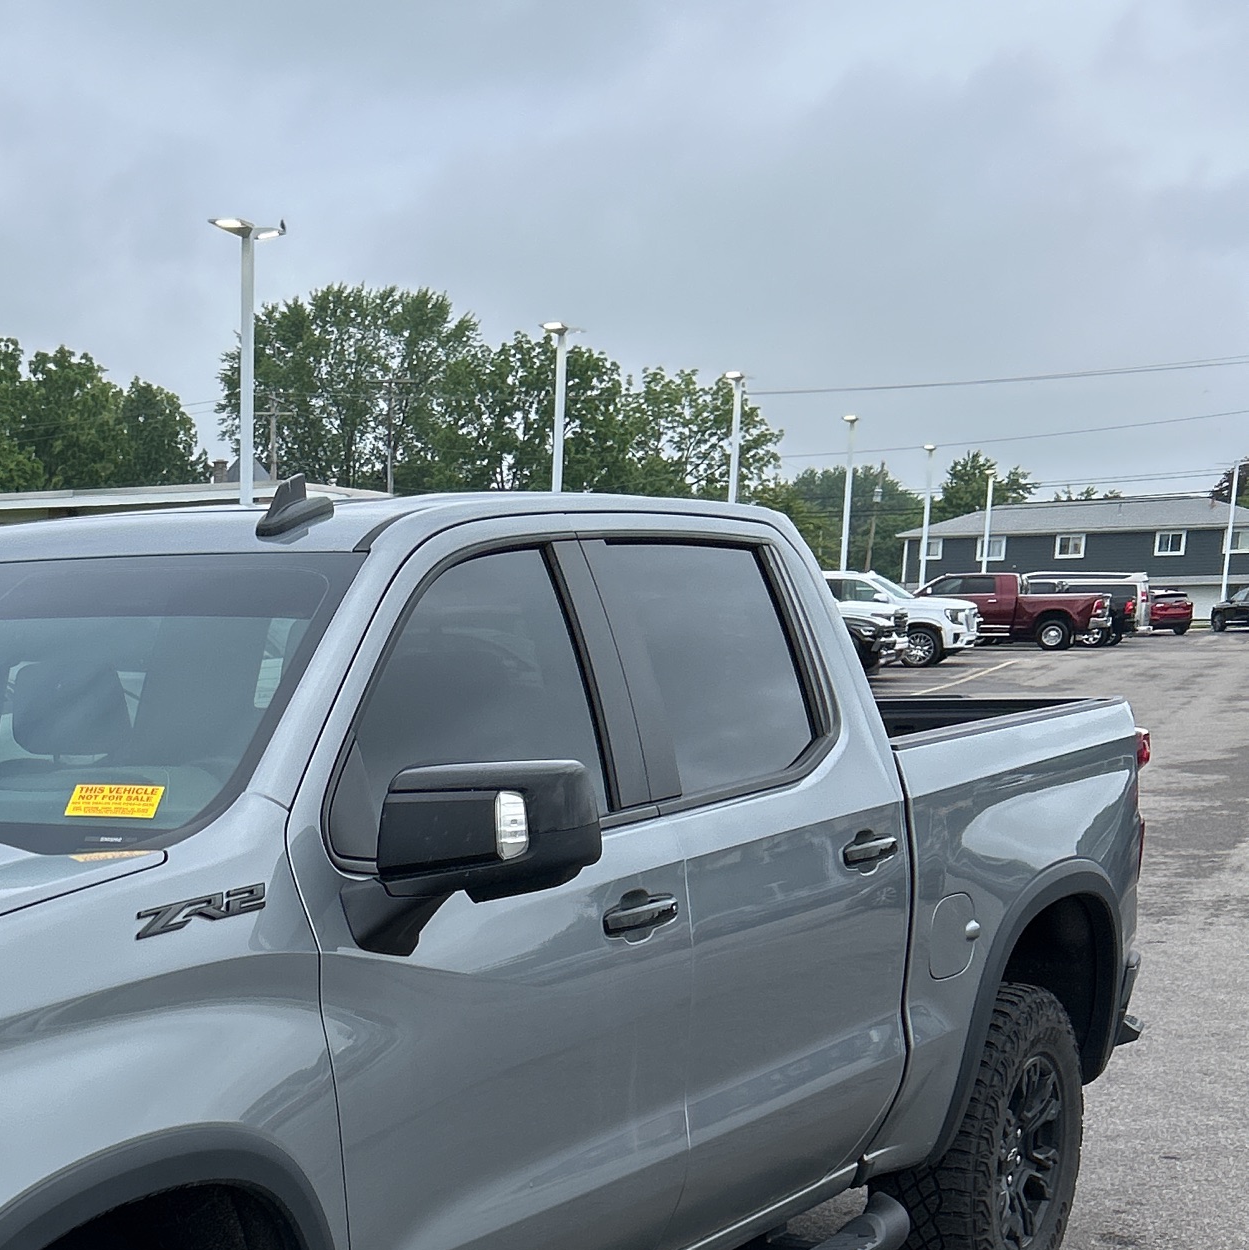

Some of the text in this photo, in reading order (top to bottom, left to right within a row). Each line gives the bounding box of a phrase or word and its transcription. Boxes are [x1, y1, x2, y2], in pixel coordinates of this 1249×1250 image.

[79, 786, 159, 795] THIS VEHICLE
[135, 882, 266, 941] ZR2
